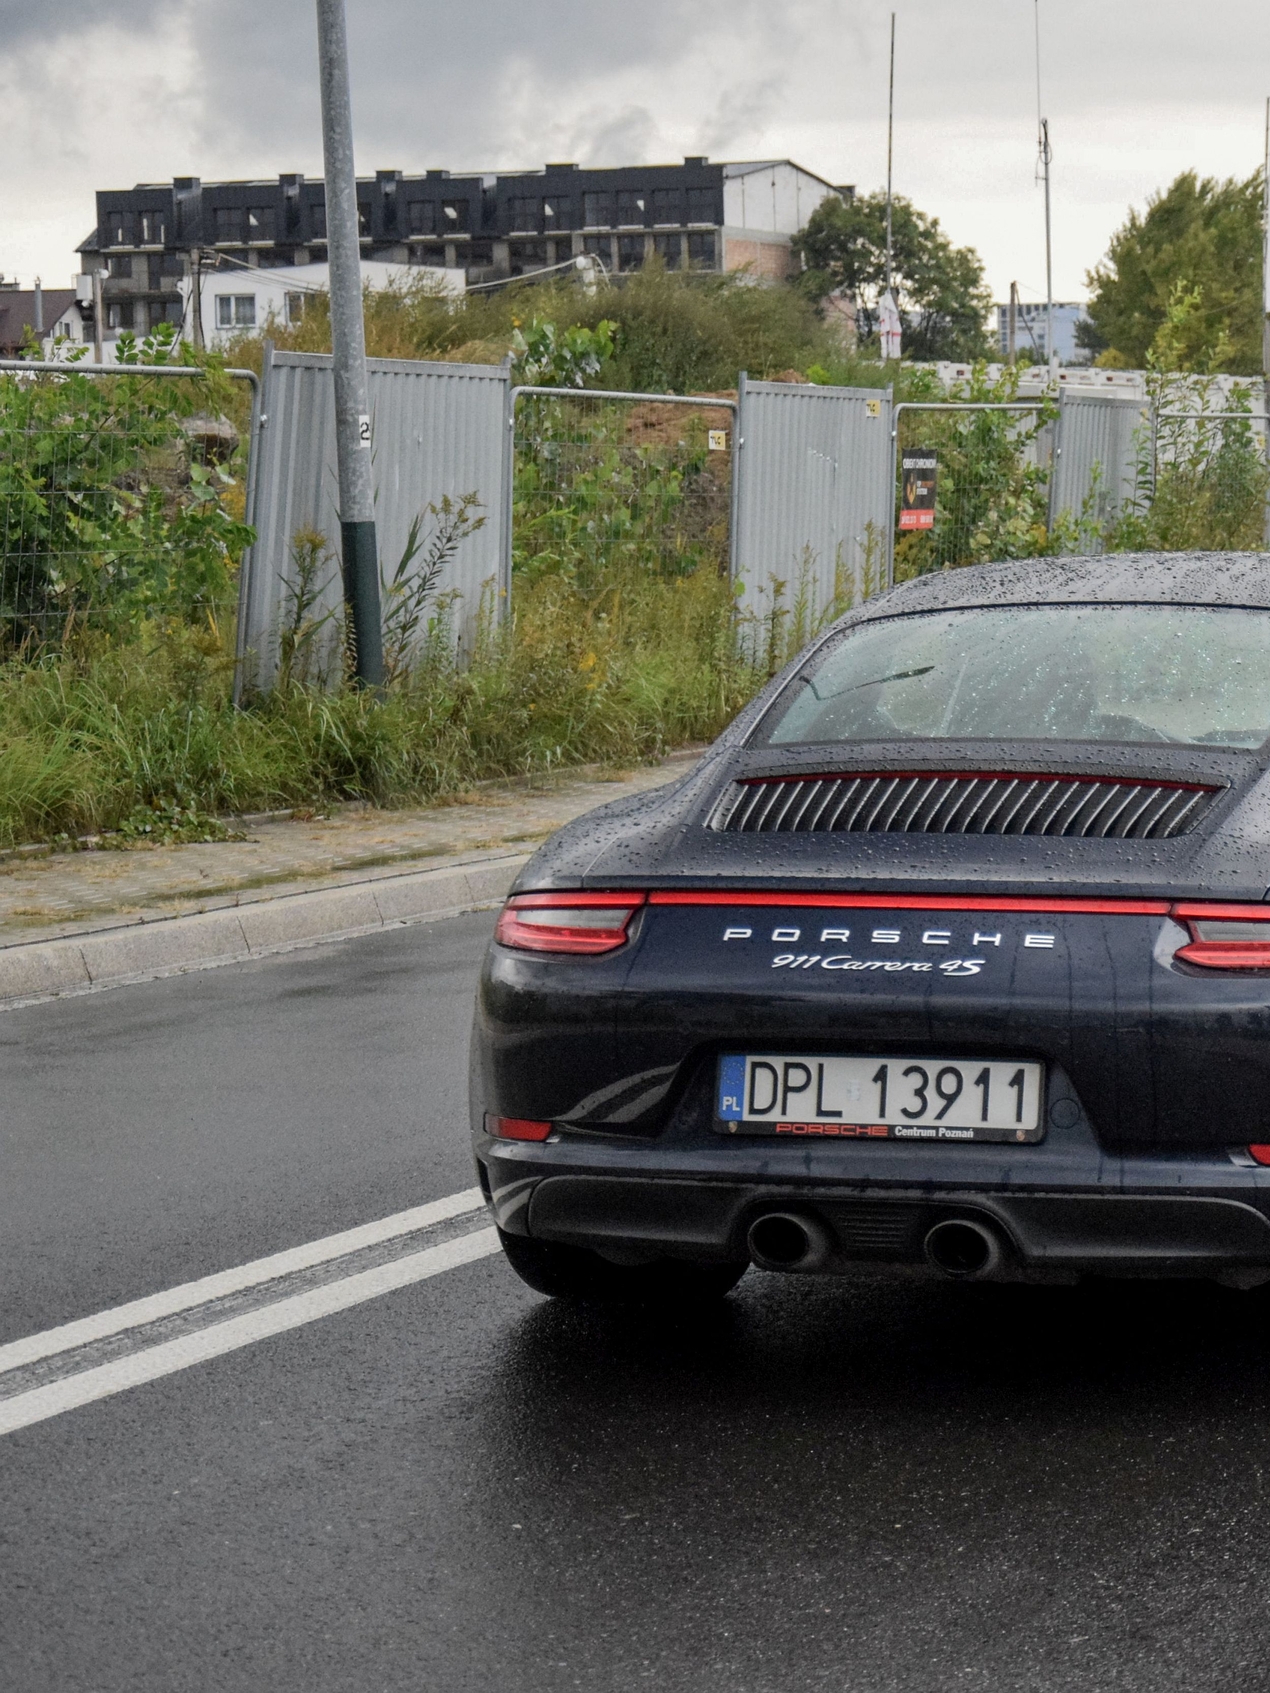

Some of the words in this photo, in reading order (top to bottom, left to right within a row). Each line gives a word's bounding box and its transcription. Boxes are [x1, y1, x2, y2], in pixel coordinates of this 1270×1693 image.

[723, 928, 1055, 948] PORSCHE
[771, 955, 821, 968] 911
[821, 955, 933, 972] Carrera
[939, 960, 986, 976] 4S
[748, 1061, 843, 1118] DPL
[872, 1064, 1025, 1122] 13911
[722, 1096, 741, 1111] PL
[776, 1123, 888, 1136] PORSCHE
[894, 1126, 936, 1138] Centrum
[938, 1127, 974, 1139] Poznań
